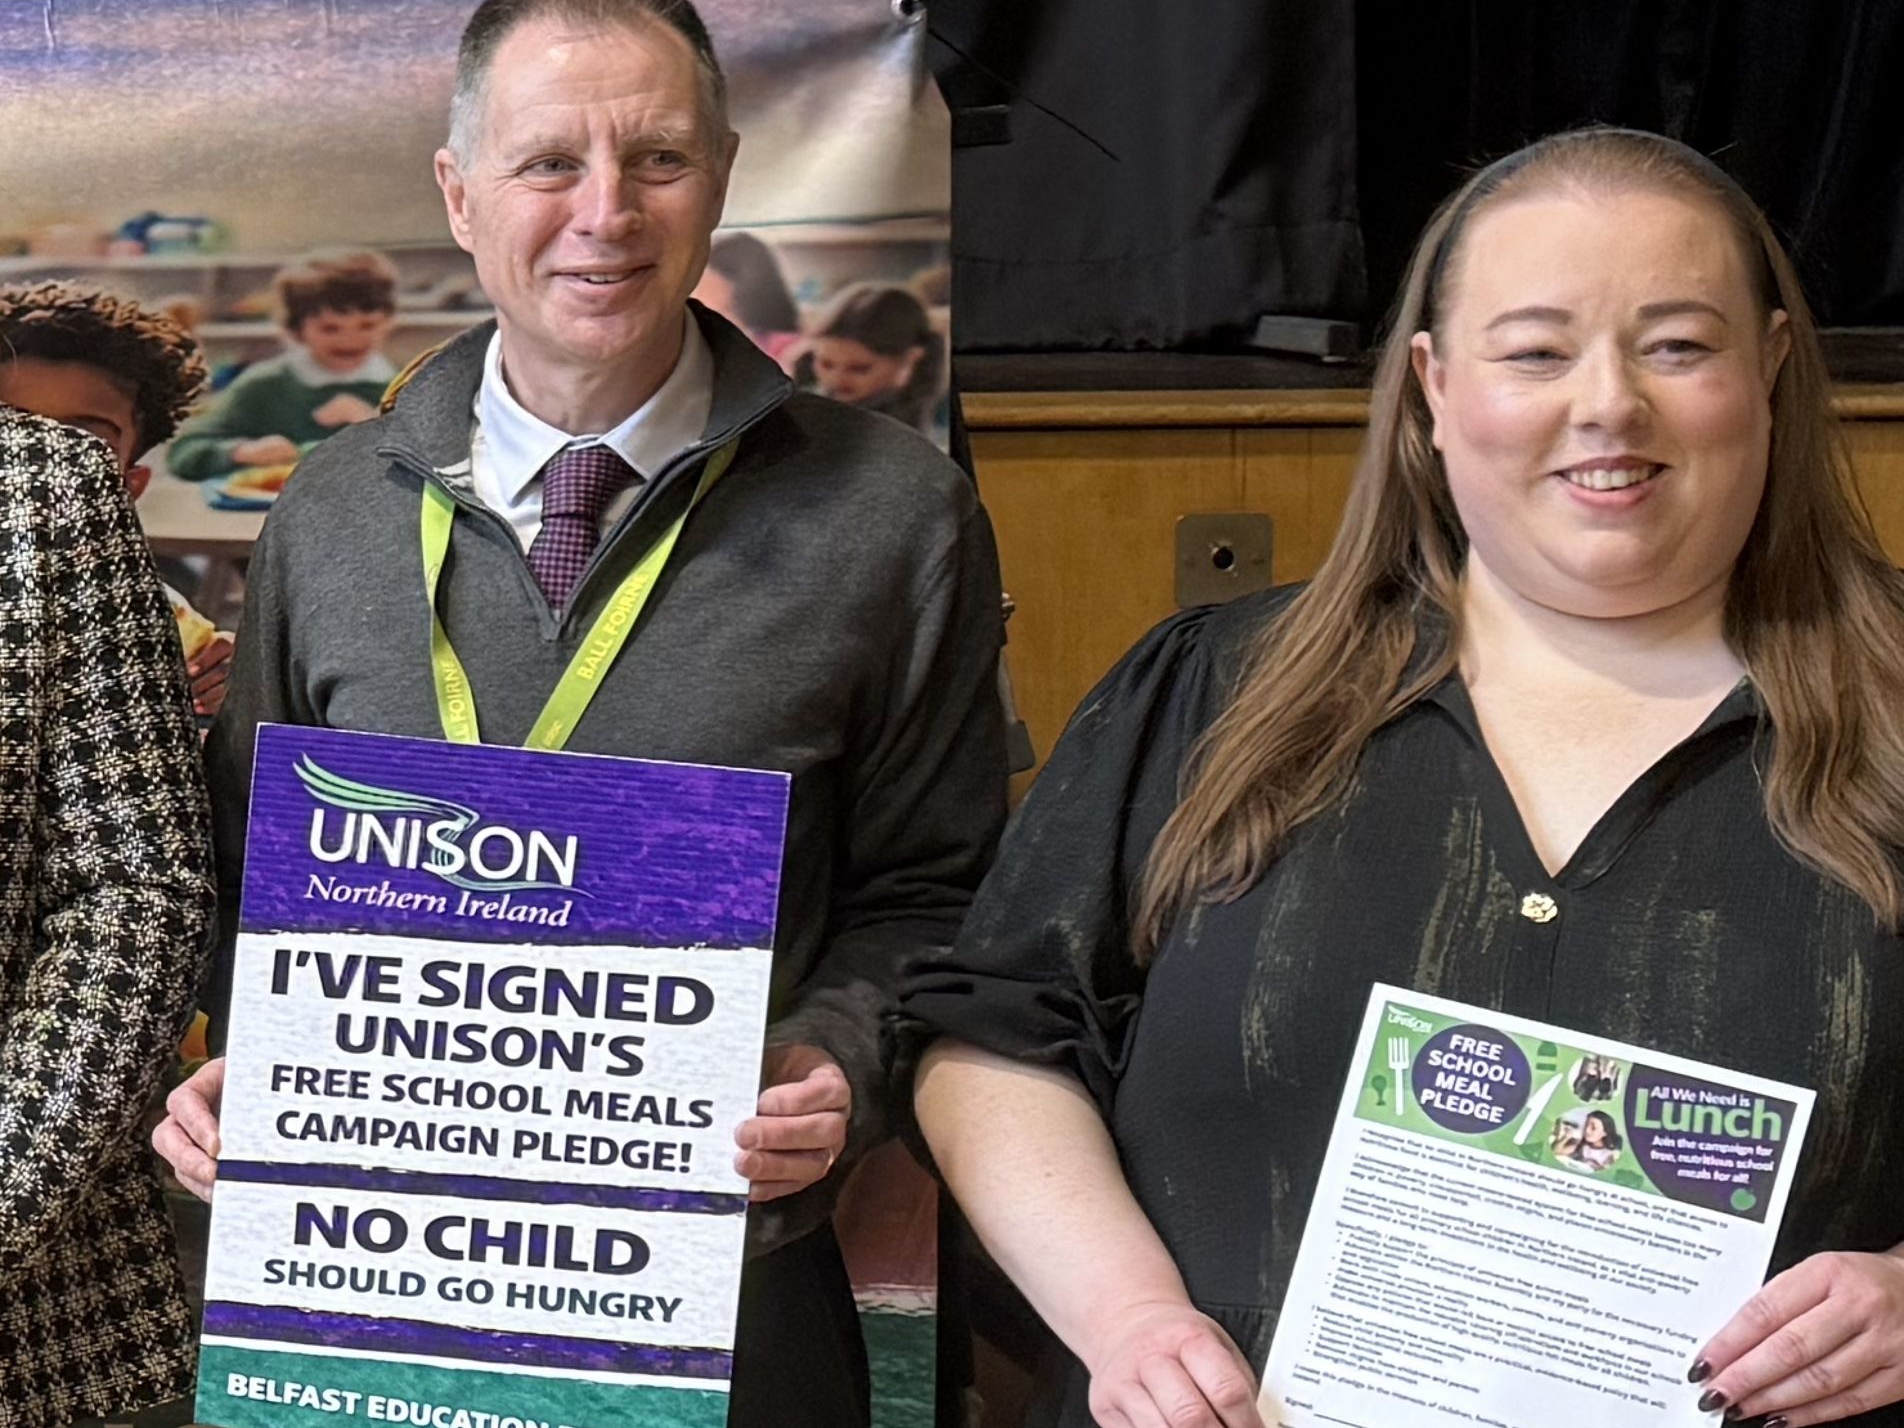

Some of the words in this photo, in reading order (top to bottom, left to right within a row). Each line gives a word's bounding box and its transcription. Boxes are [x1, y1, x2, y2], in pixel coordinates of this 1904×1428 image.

[576, 639, 613, 680] BALL
[308, 808, 577, 886] UNISON
[304, 874, 447, 915] Northern
[456, 890, 574, 928] Ireland
[270, 948, 403, 1004] I'VE
[418, 959, 716, 1027] SIGNED
[335, 1013, 646, 1077] UNISON'S
[1428, 1050, 1516, 1086] SCHOOL
[1450, 1034, 1504, 1061] FREE
[270, 1064, 371, 1101] FREE
[382, 1073, 552, 1117] SCHOOL
[564, 1089, 715, 1129] MEALS
[1420, 1089, 1505, 1124] PLEDGE
[1435, 1072, 1493, 1101] MEAL
[1651, 1086, 1669, 1099] All
[1672, 1088, 1697, 1102] We
[1699, 1091, 1736, 1106] Need
[1634, 1088, 1782, 1141] Lunch
[275, 1110, 500, 1158] CAMPAIGN
[513, 1128, 694, 1173] PLEDGE!
[293, 1202, 409, 1254] NO
[423, 1214, 652, 1276] CHILD
[263, 1258, 426, 1298] SHOULD
[437, 1276, 493, 1306] GO
[505, 1283, 684, 1324] HUNGRY
[227, 1372, 362, 1415] BELFAST
